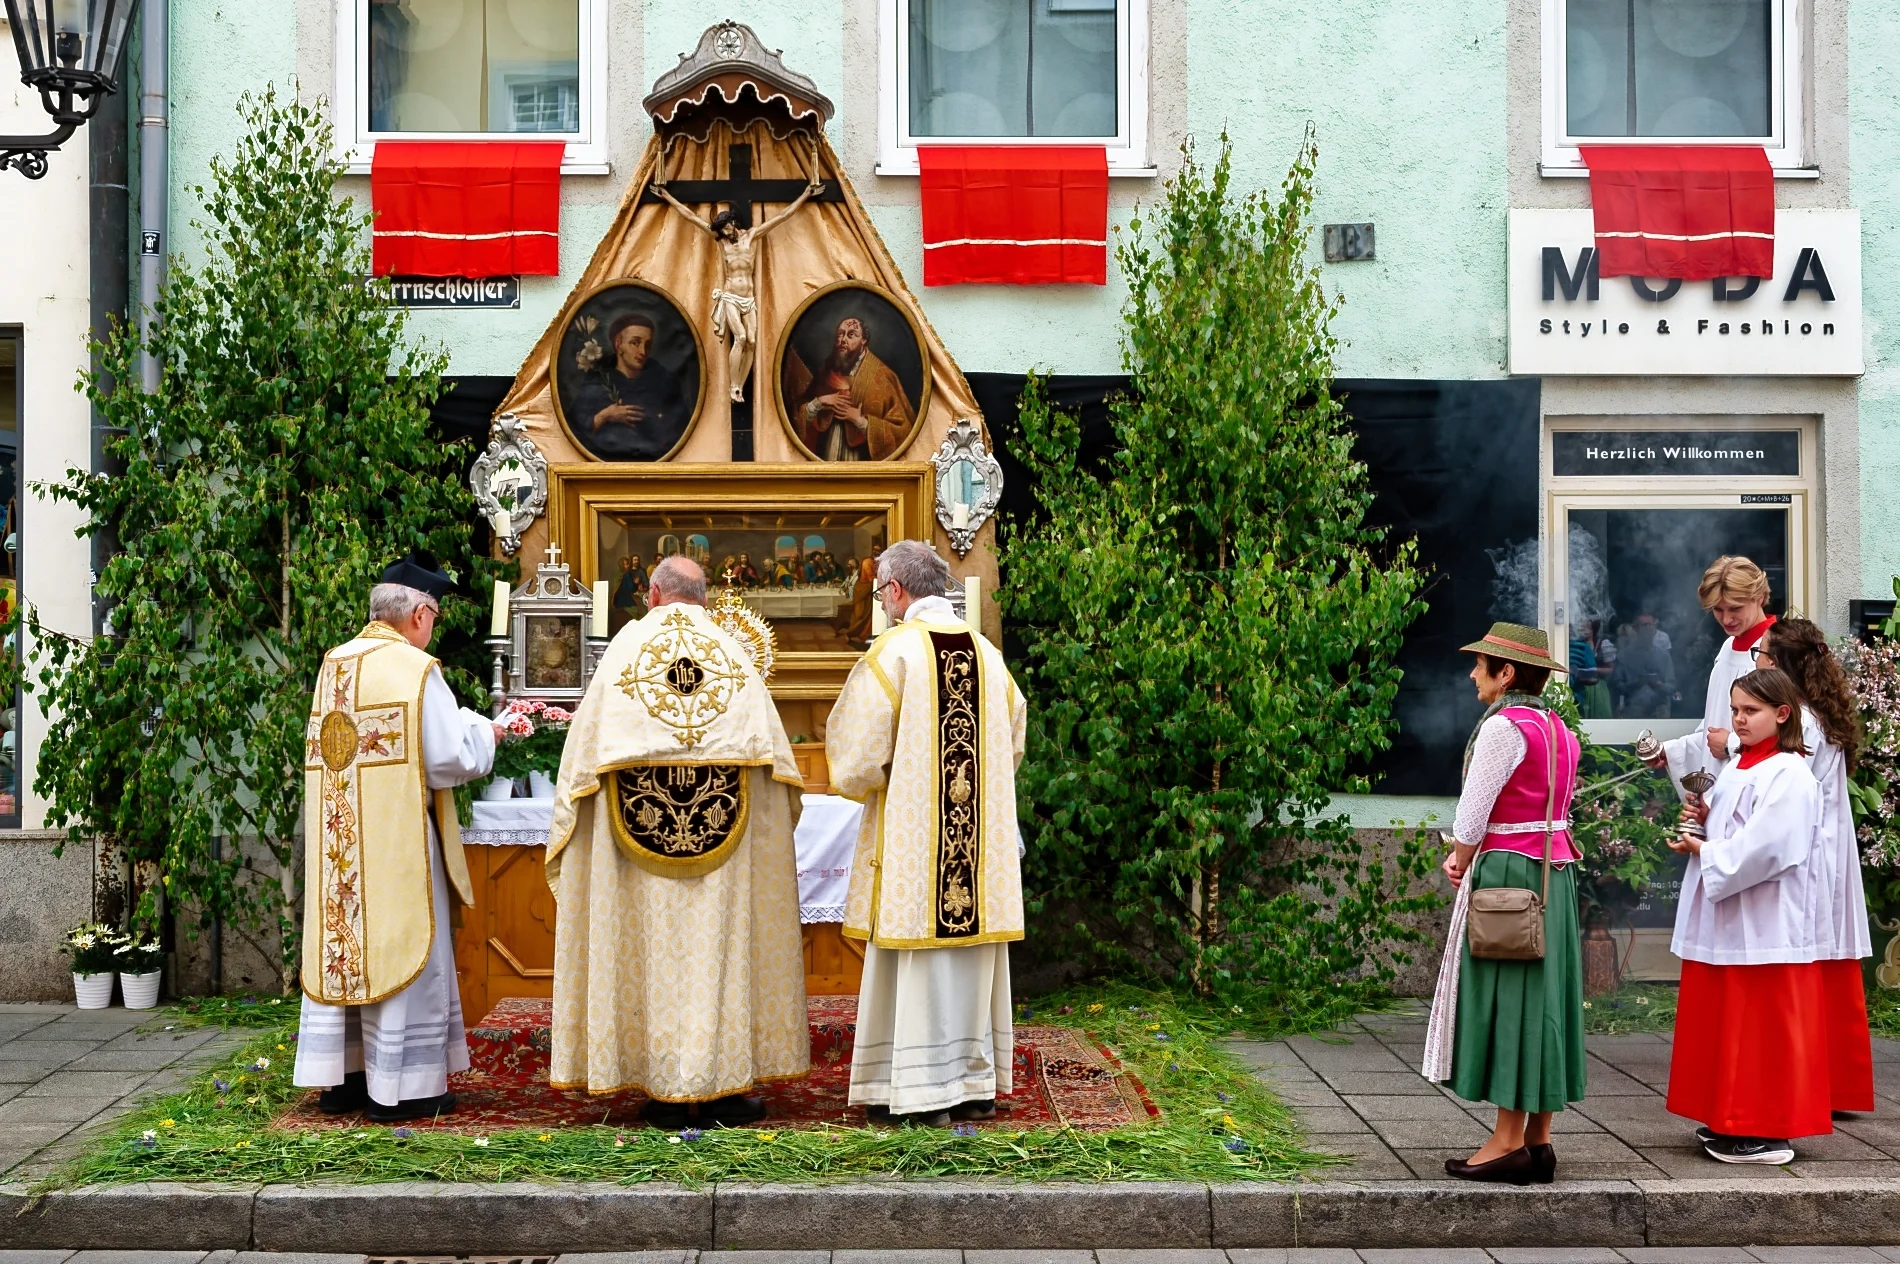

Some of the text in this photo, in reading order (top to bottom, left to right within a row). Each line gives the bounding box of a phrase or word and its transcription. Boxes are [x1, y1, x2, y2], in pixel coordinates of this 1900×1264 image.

[1540, 318, 1836, 338] Style & Fashion
[1586, 446, 1765, 459] Herzlich Willkommen
